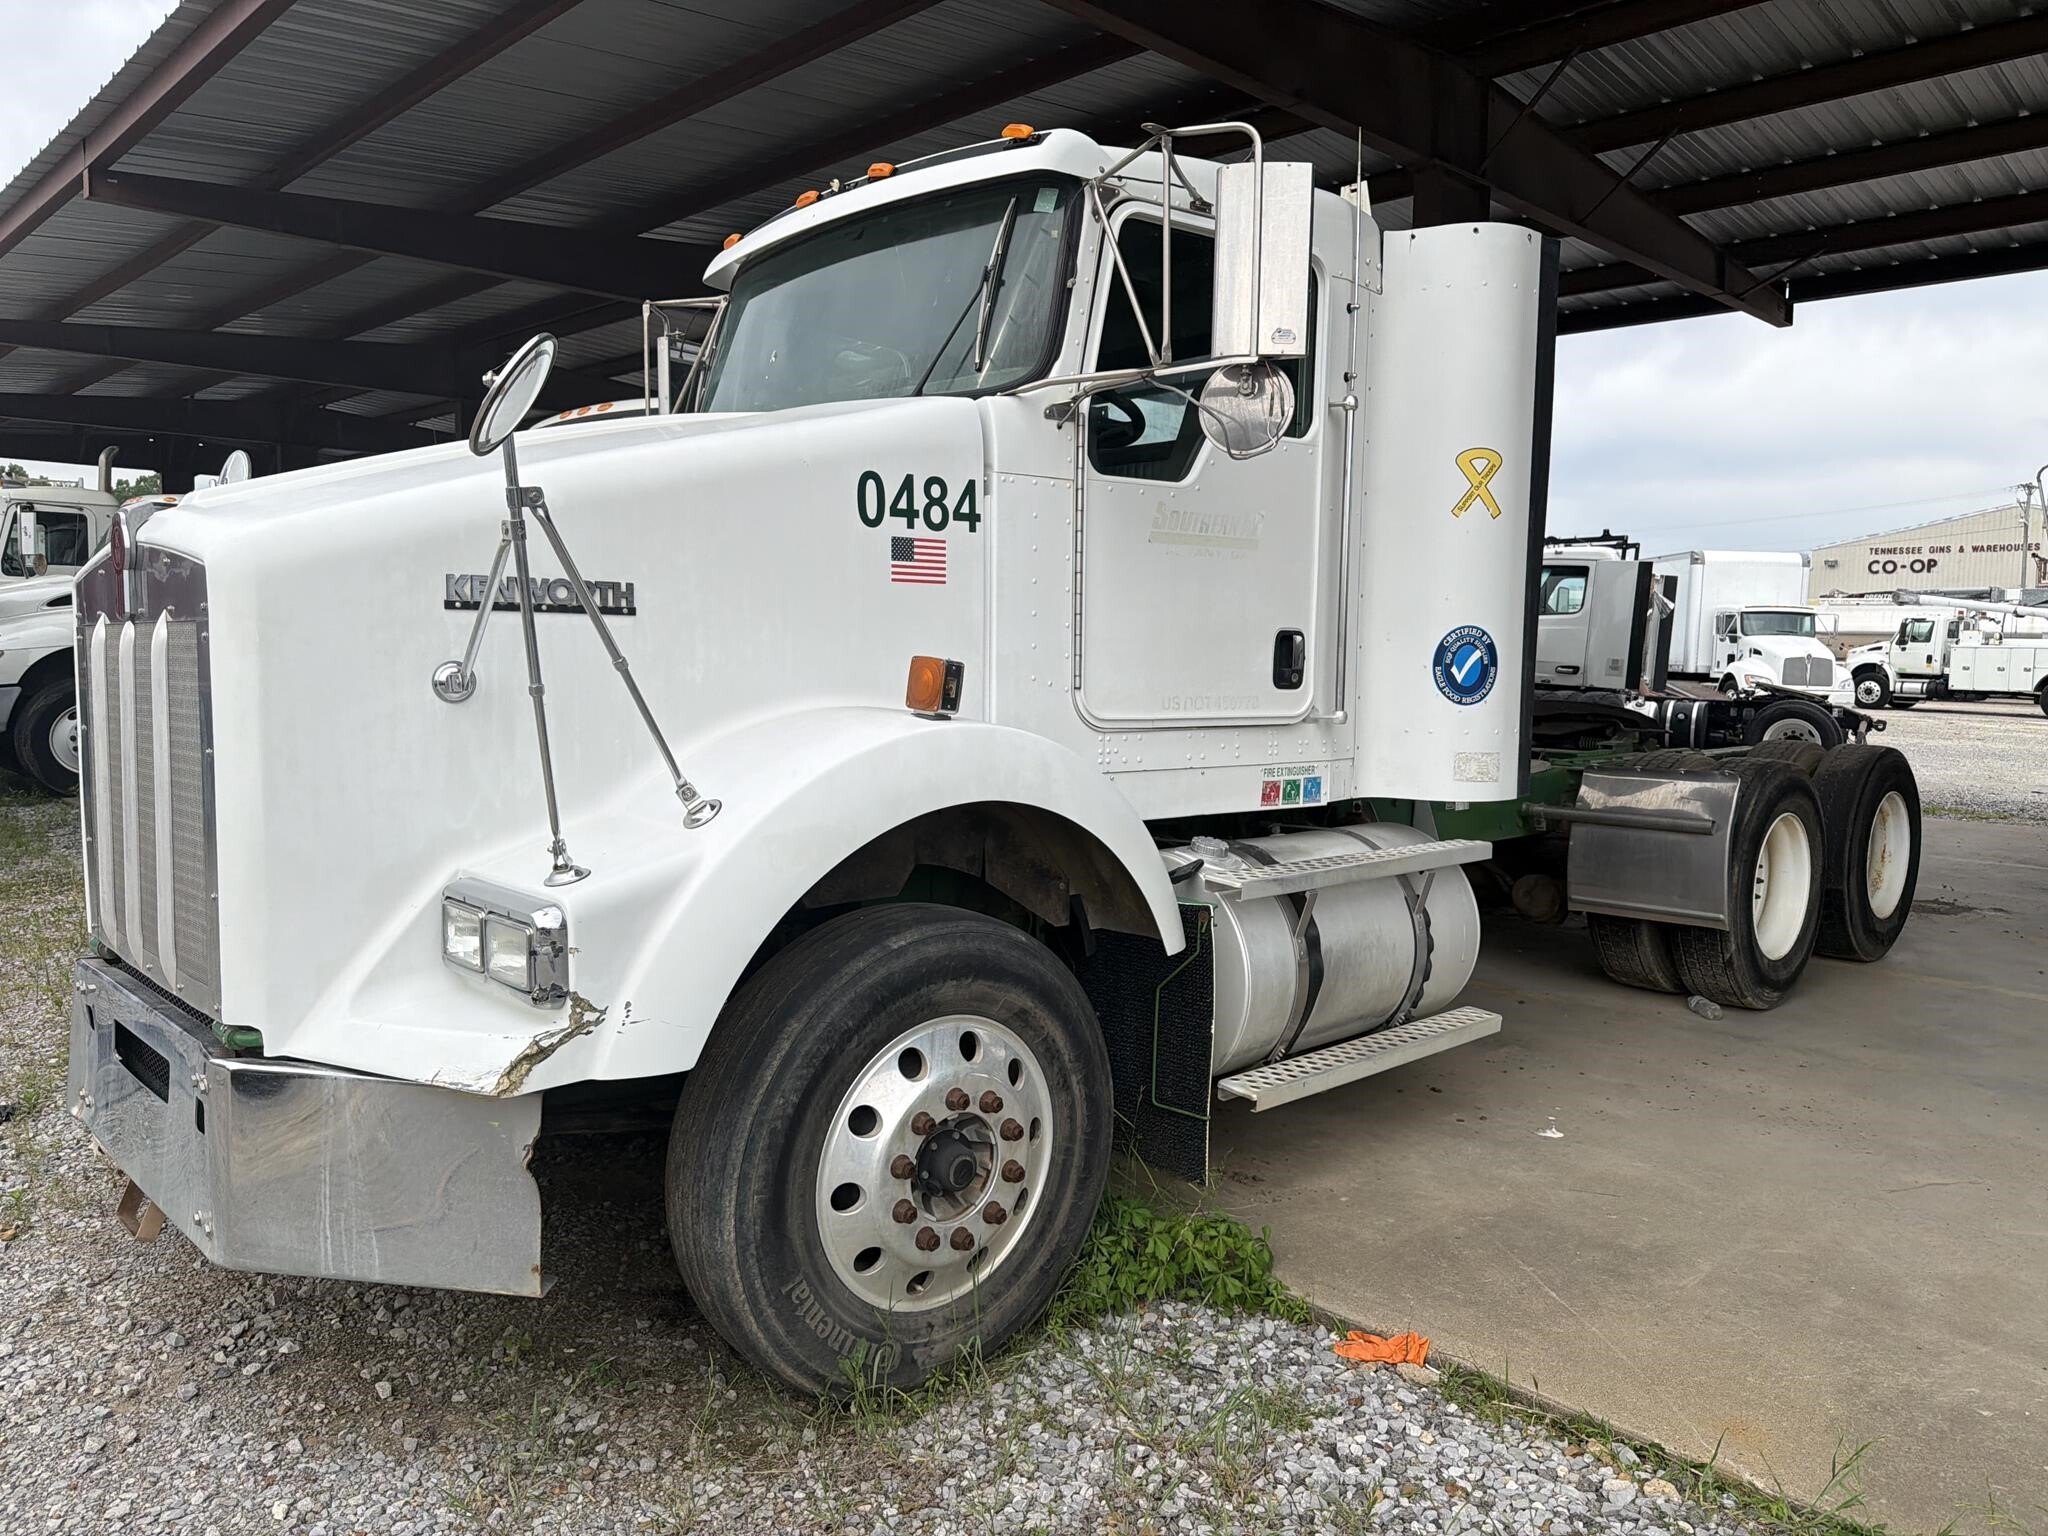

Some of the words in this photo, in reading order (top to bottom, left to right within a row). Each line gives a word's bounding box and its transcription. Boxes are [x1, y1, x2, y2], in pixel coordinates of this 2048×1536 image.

[1457, 491, 1475, 511] SUPPORT
[1474, 480, 1484, 492] OUR
[1481, 463, 1497, 481] TROOPS
[857, 470, 982, 533] 0484
[1869, 547, 1923, 555] TENNESSEE
[1928, 545, 1952, 554] GINS
[1958, 545, 1965, 553] &
[1867, 559, 1938, 575] CO-OP
[1443, 627, 1483, 647] CERTIFIED
[1481, 634, 1492, 645] BY
[1449, 637, 1475, 653] QUALITY
[1474, 639, 1489, 665] SUPPLIER
[1434, 666, 1447, 688] EAGLE
[1442, 686, 1461, 702] FOOD
[1263, 767, 1277, 778] FIRE
[1276, 764, 1317, 777] EXTINGUISHER
